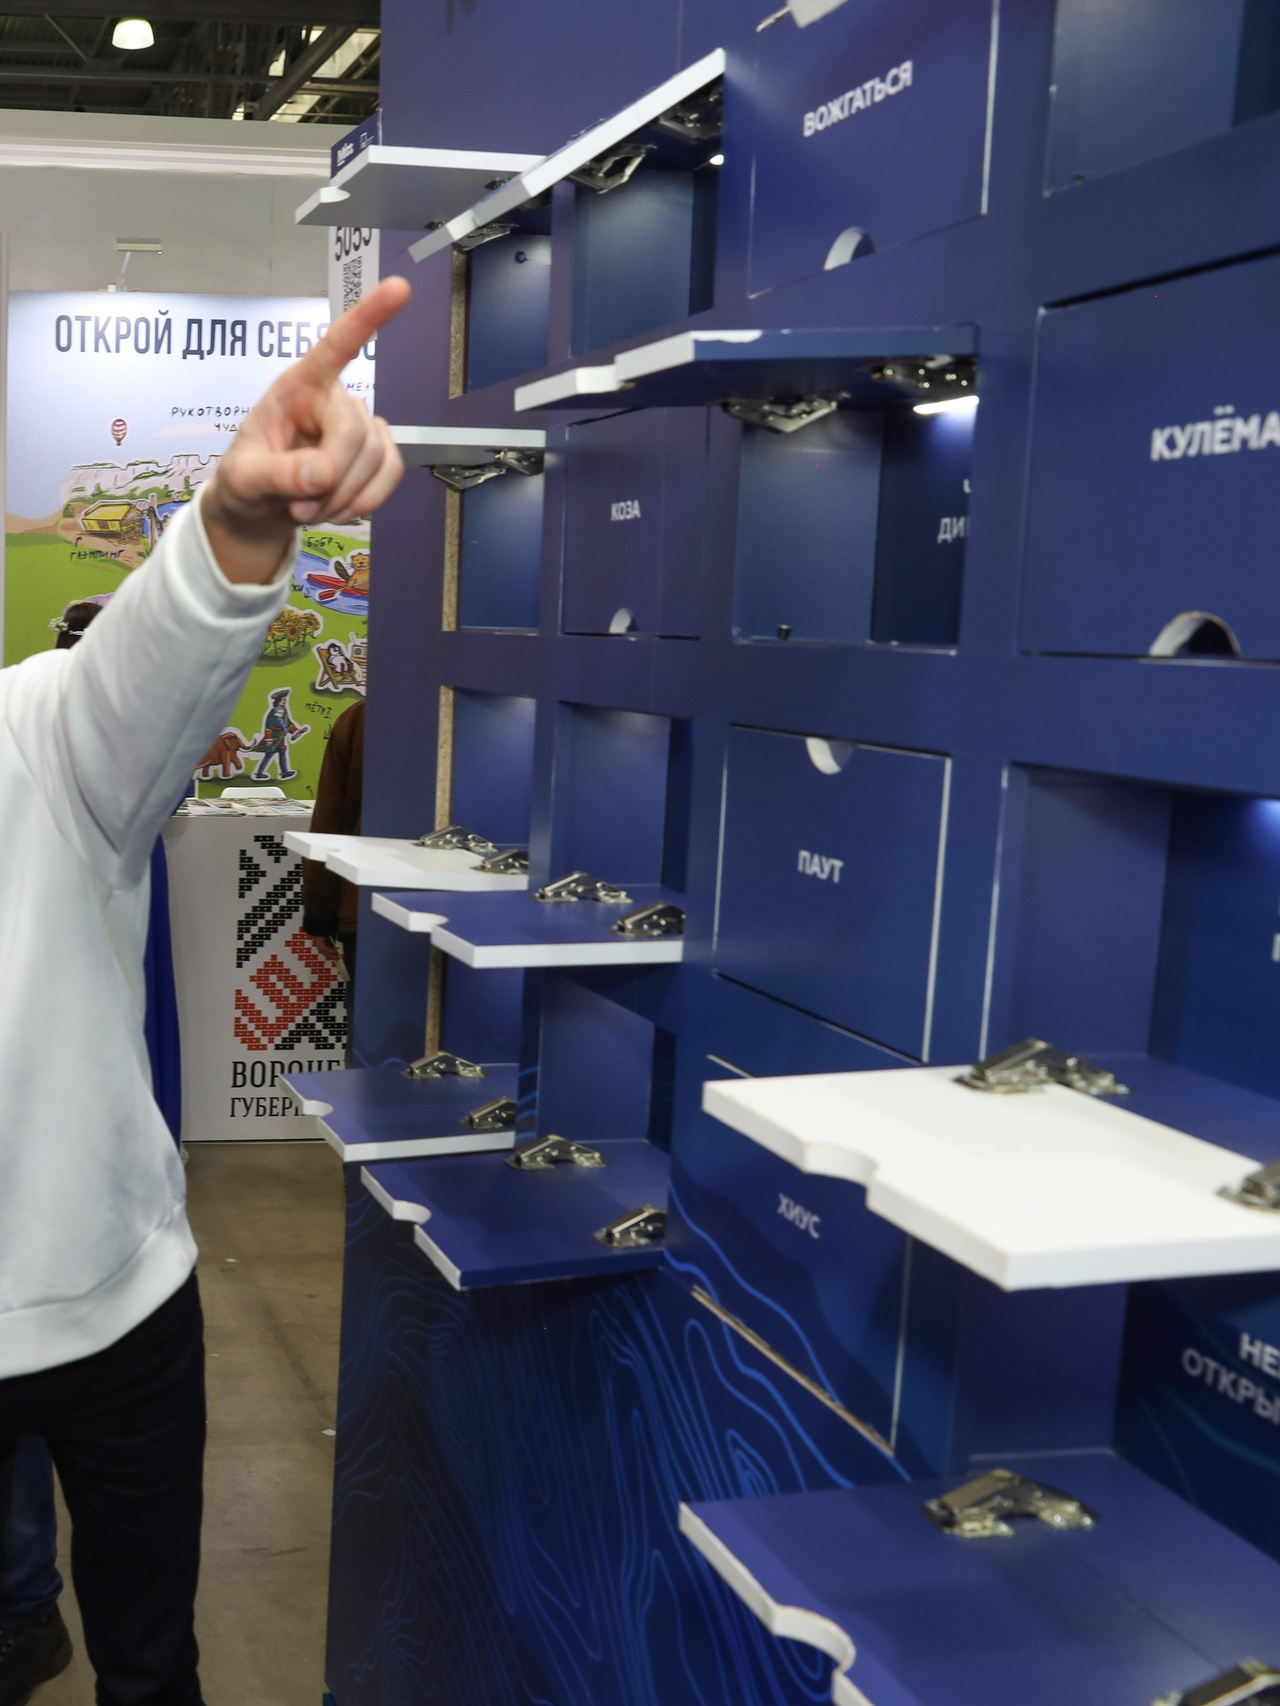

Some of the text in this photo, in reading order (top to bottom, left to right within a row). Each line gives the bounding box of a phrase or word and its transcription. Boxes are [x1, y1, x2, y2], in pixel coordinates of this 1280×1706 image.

[803, 60, 913, 137] ВОЖГАТЬСЯ
[55, 309, 172, 355] ОТКРОЙ
[182, 318, 247, 360] ДЛЯ
[1150, 405, 1280, 461] КУЛЁМА
[611, 499, 641, 521] КОЗА
[798, 849, 844, 884] ПАУТ
[778, 1192, 821, 1239] ХИУС
